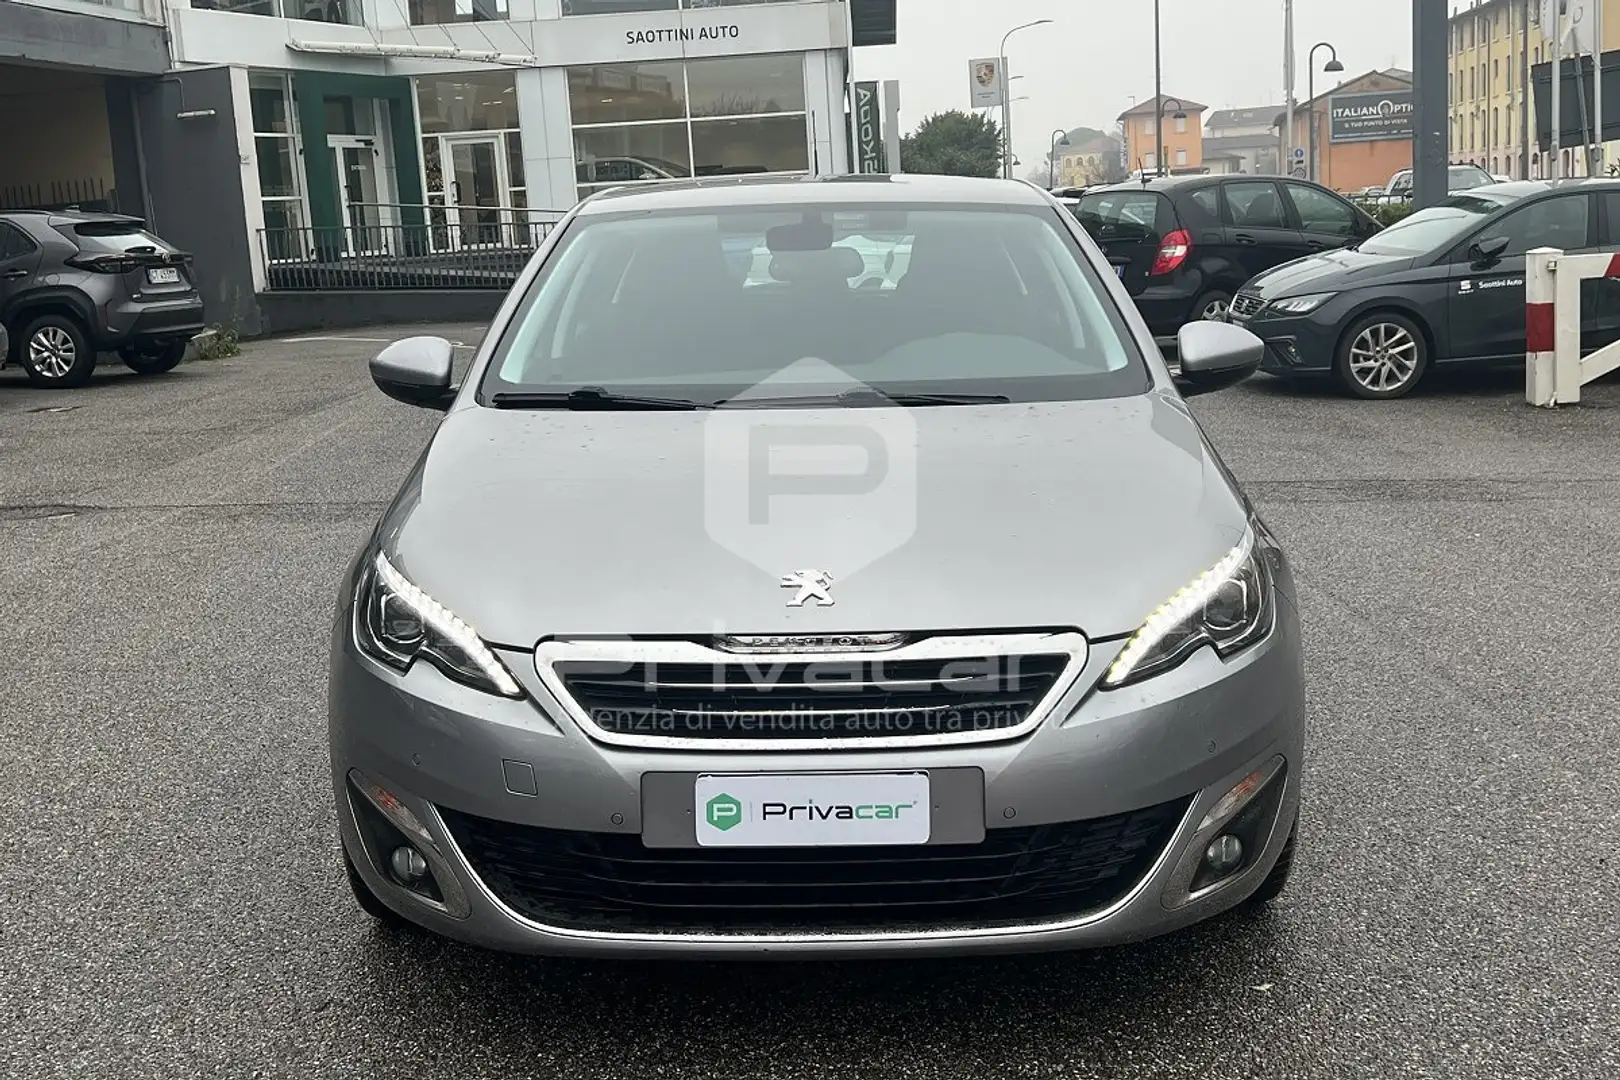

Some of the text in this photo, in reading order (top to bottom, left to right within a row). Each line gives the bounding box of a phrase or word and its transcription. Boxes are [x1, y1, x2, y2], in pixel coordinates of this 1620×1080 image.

[626, 25, 739, 45] SAOTTINI AUTO
[1506, 279, 1523, 287] Auto
